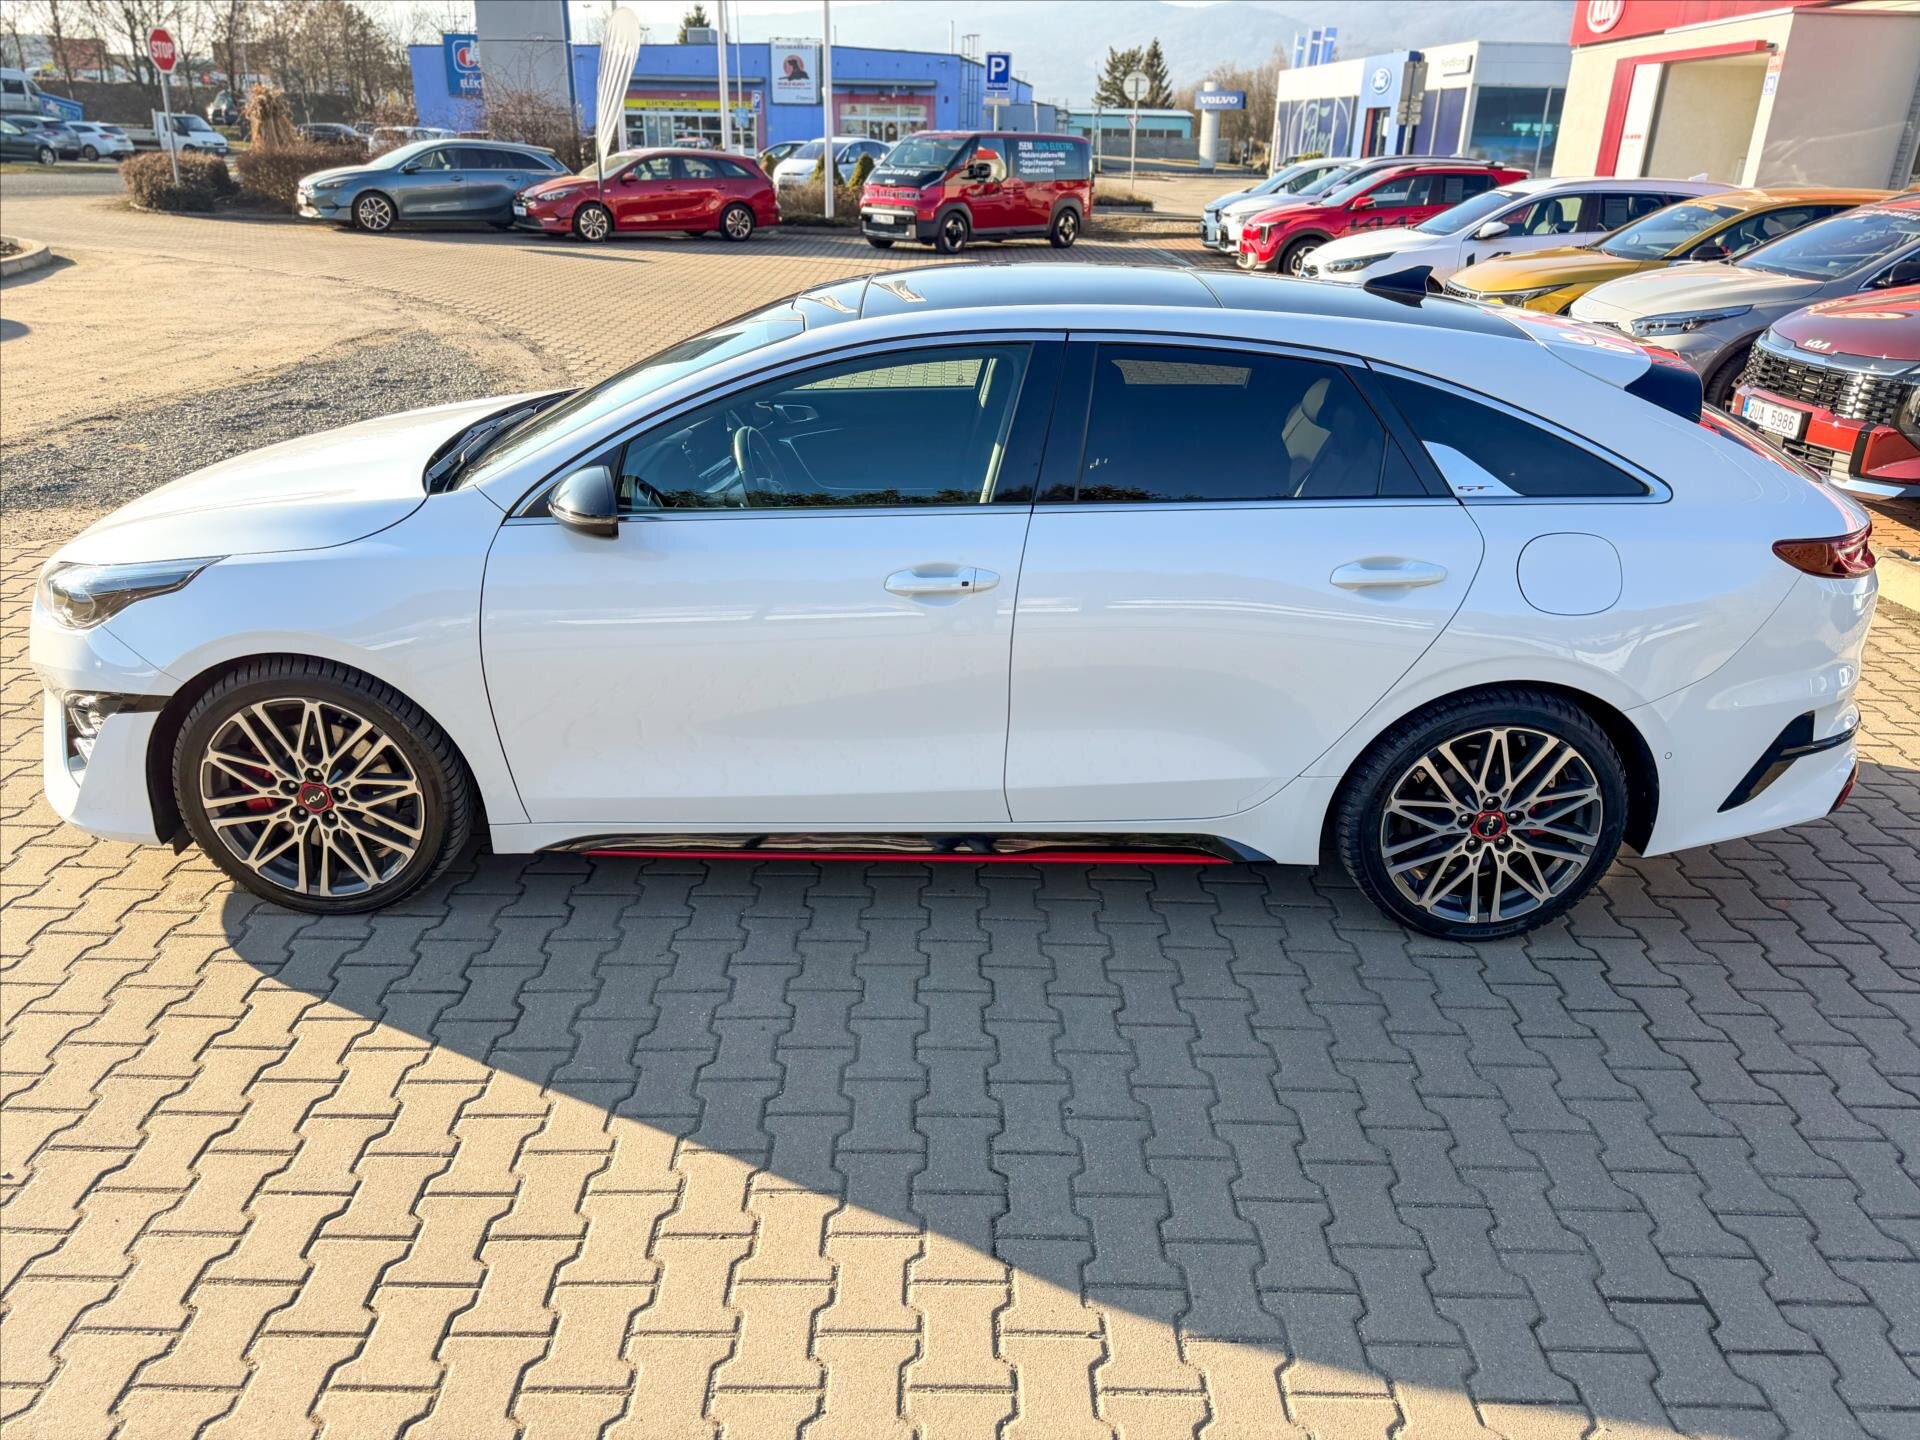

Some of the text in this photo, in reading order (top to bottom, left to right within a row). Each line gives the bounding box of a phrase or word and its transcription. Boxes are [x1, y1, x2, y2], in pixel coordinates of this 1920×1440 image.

[151, 40, 174, 59] STOP
[990, 57, 1006, 80] P
[1200, 95, 1239, 105] VOLVO
[1804, 339, 1831, 351] KIA
[1748, 402, 1796, 431] 2UA 5986
[304, 791, 325, 805] KIA
